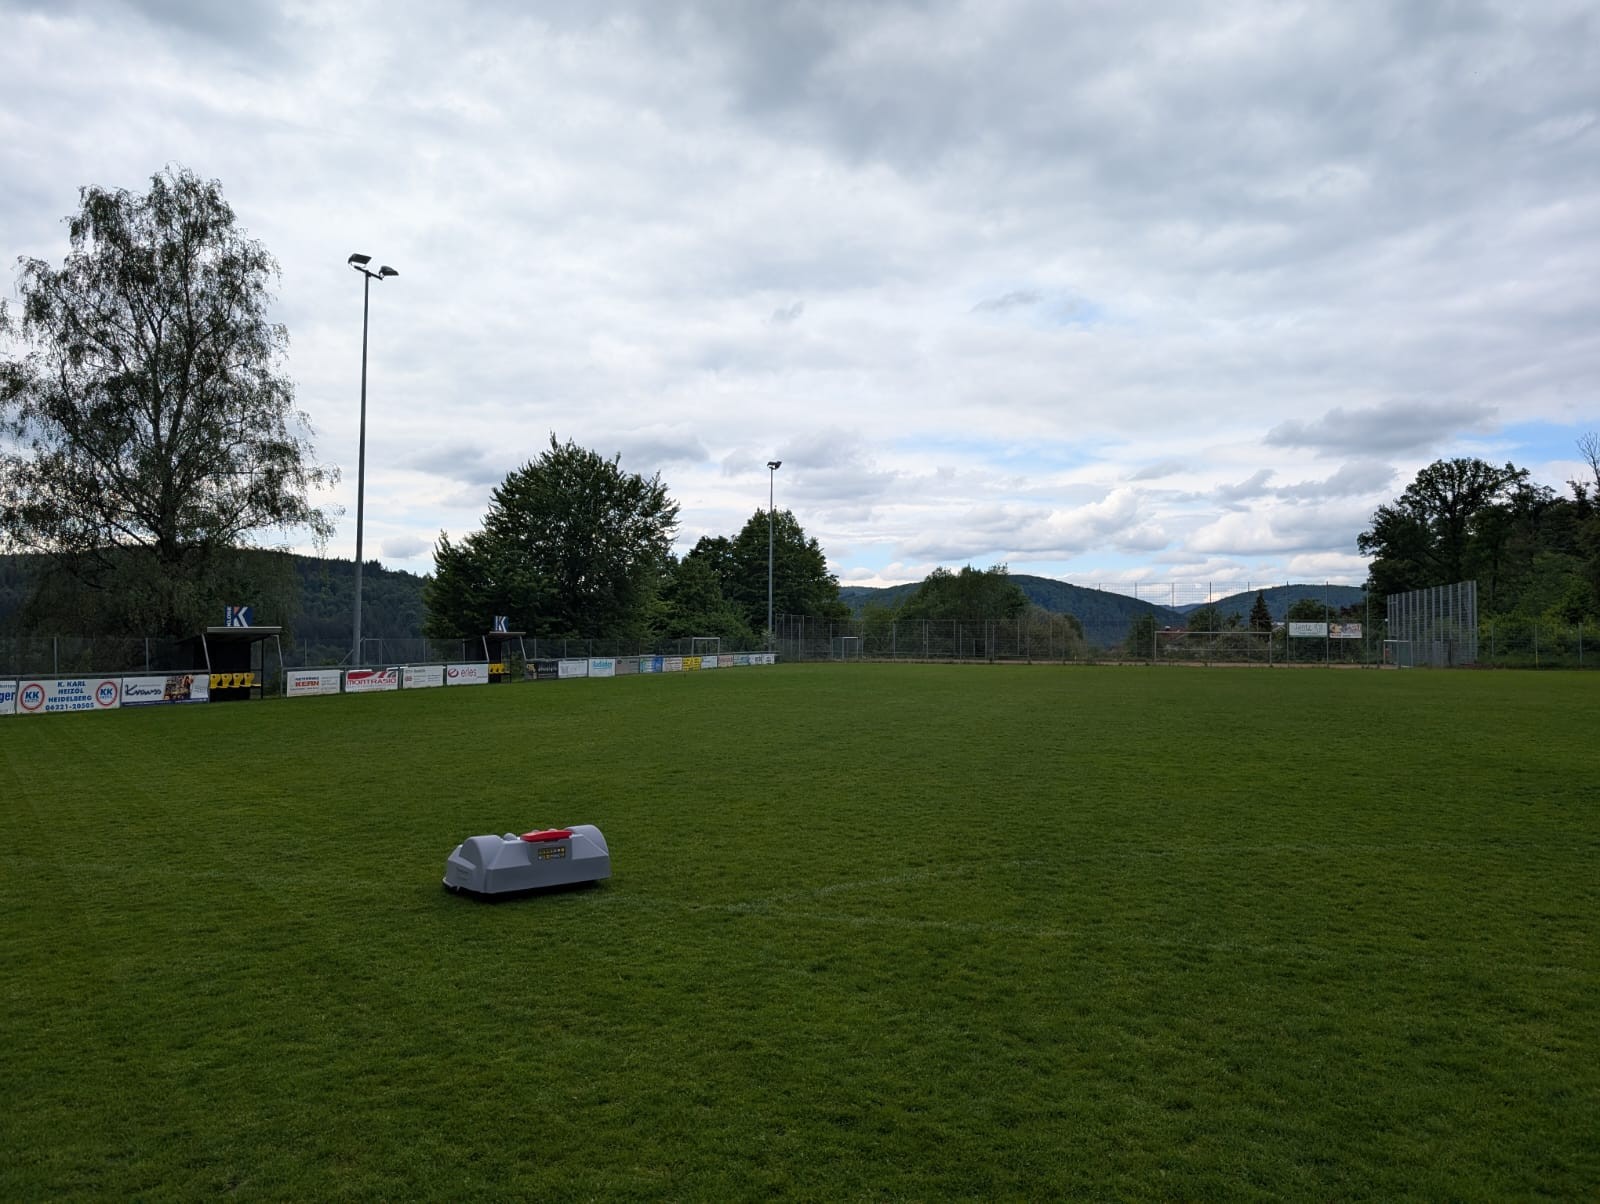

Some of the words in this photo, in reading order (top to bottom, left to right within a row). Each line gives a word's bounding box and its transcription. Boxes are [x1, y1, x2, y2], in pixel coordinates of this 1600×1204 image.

[460, 667, 477, 678] erles
[66, 680, 86, 688] KARL
[295, 680, 320, 688] KERN
[25, 691, 40, 700] KK
[100, 687, 113, 696] KK
[48, 695, 93, 703] HEIDELBERG
